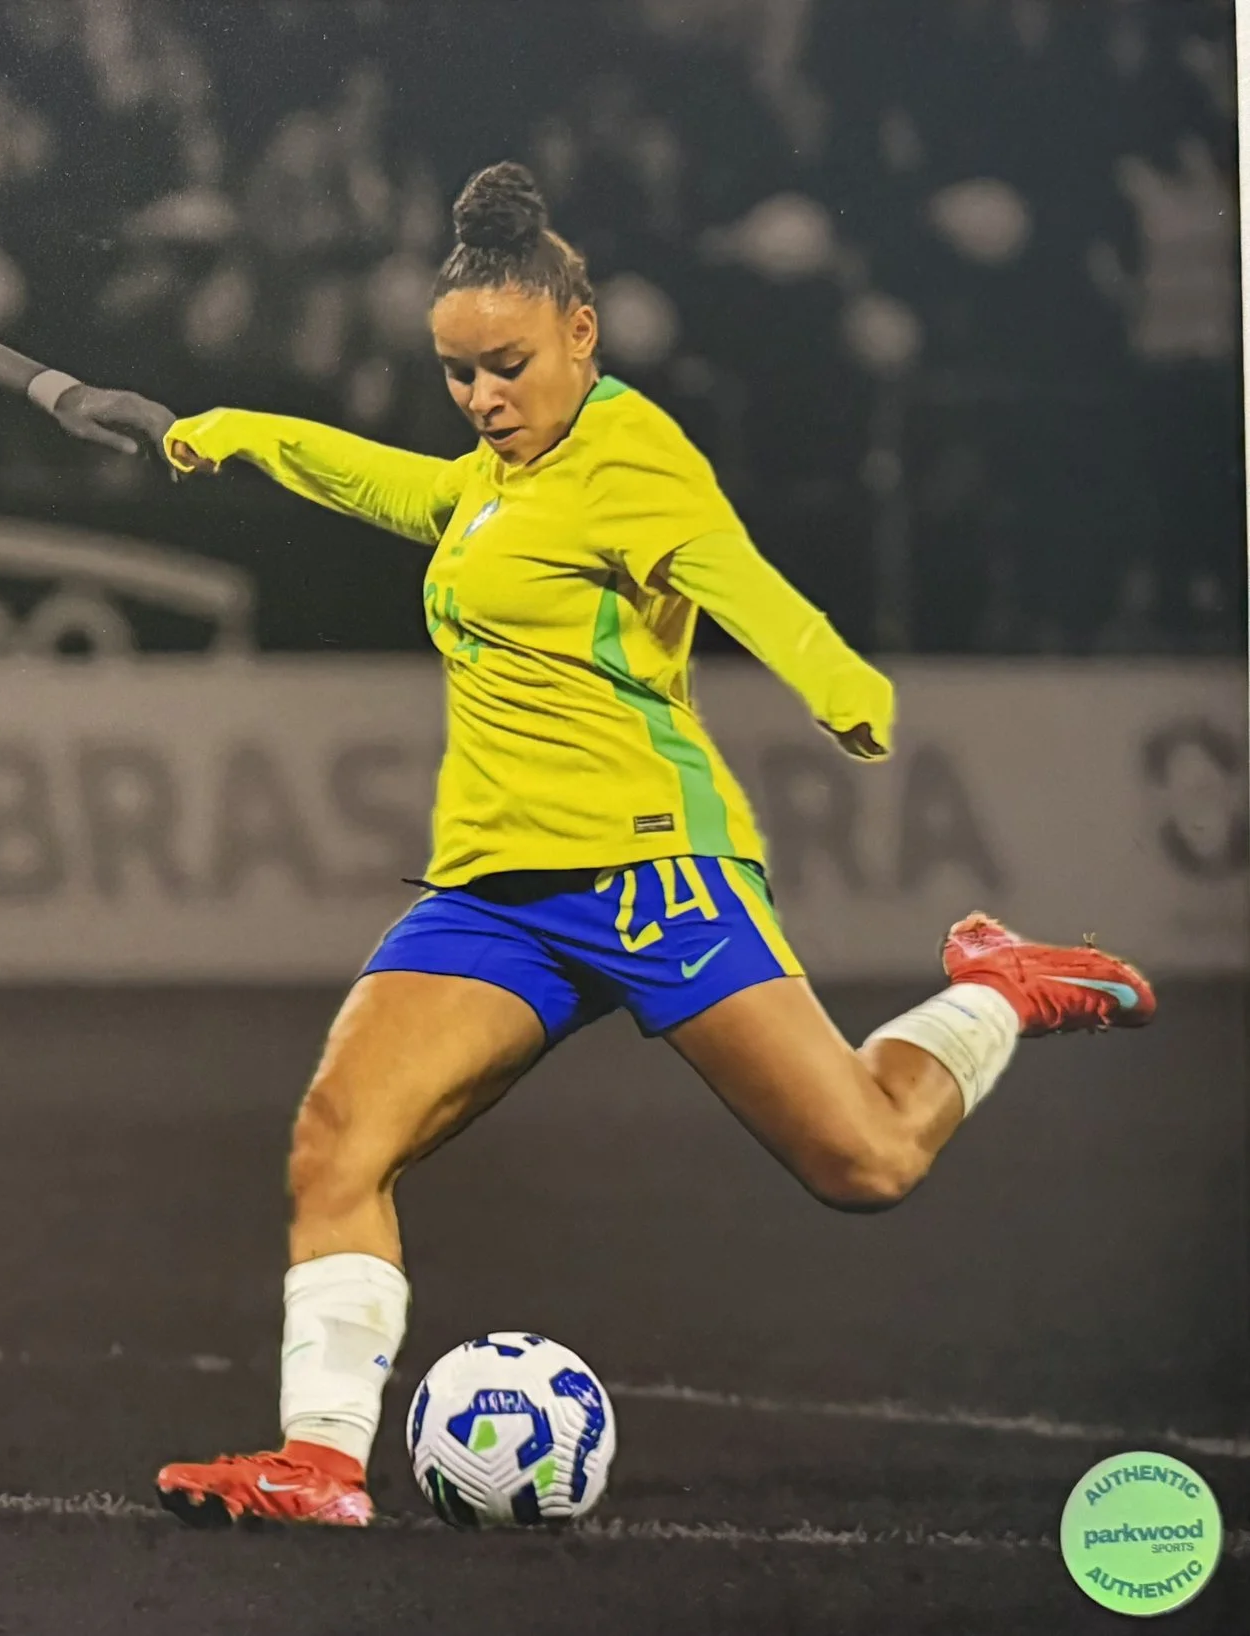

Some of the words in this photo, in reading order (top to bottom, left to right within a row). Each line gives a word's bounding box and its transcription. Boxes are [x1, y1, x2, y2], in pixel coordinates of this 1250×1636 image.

[594, 856, 720, 953] 24
[1083, 1464, 1201, 1506] AUTHENTIC
[1084, 1518, 1203, 1549] parkwood
[1151, 1541, 1195, 1554] SPORTS
[1085, 1559, 1203, 1599] AUTHENTIC
